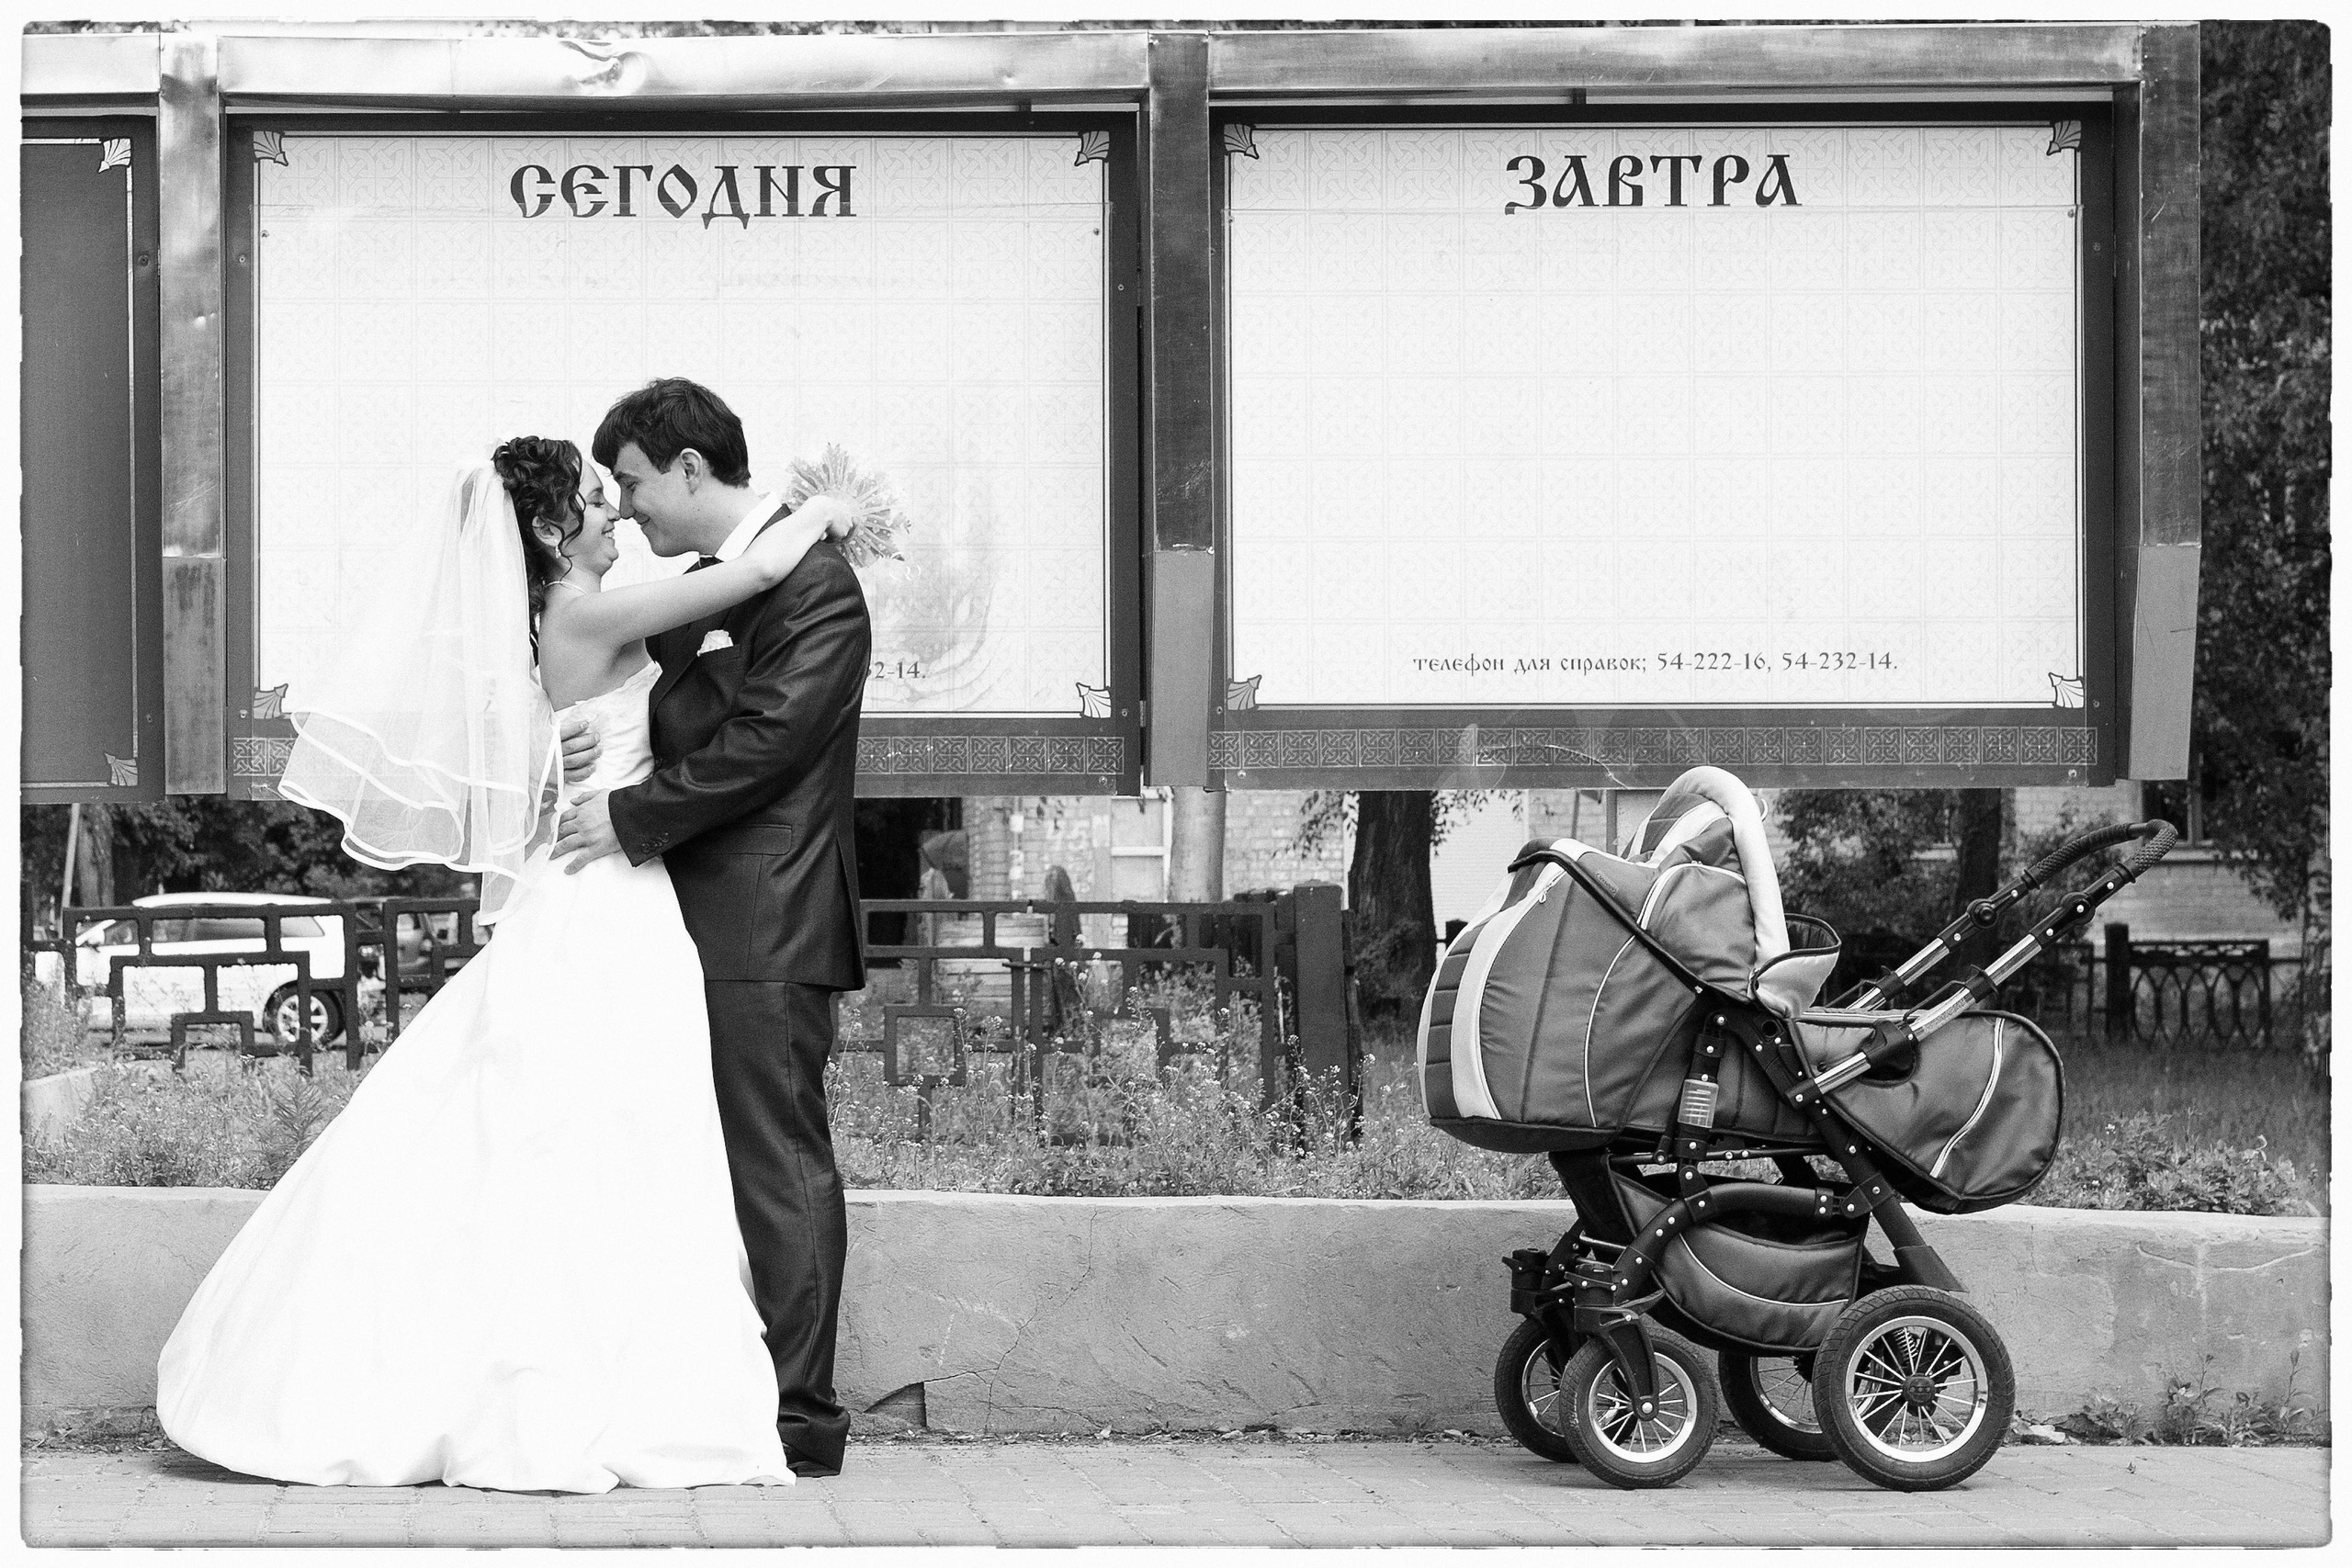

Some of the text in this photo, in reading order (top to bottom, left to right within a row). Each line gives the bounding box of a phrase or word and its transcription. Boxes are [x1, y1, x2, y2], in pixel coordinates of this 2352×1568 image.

[510, 164, 857, 230] СЕГОДНЯ
[1504, 153, 1803, 216] ЗАВТРА
[866, 660, 926, 680] 2-14.
[1412, 651, 1898, 677] телефон для справок; 54-222-16, 54-232-14.
